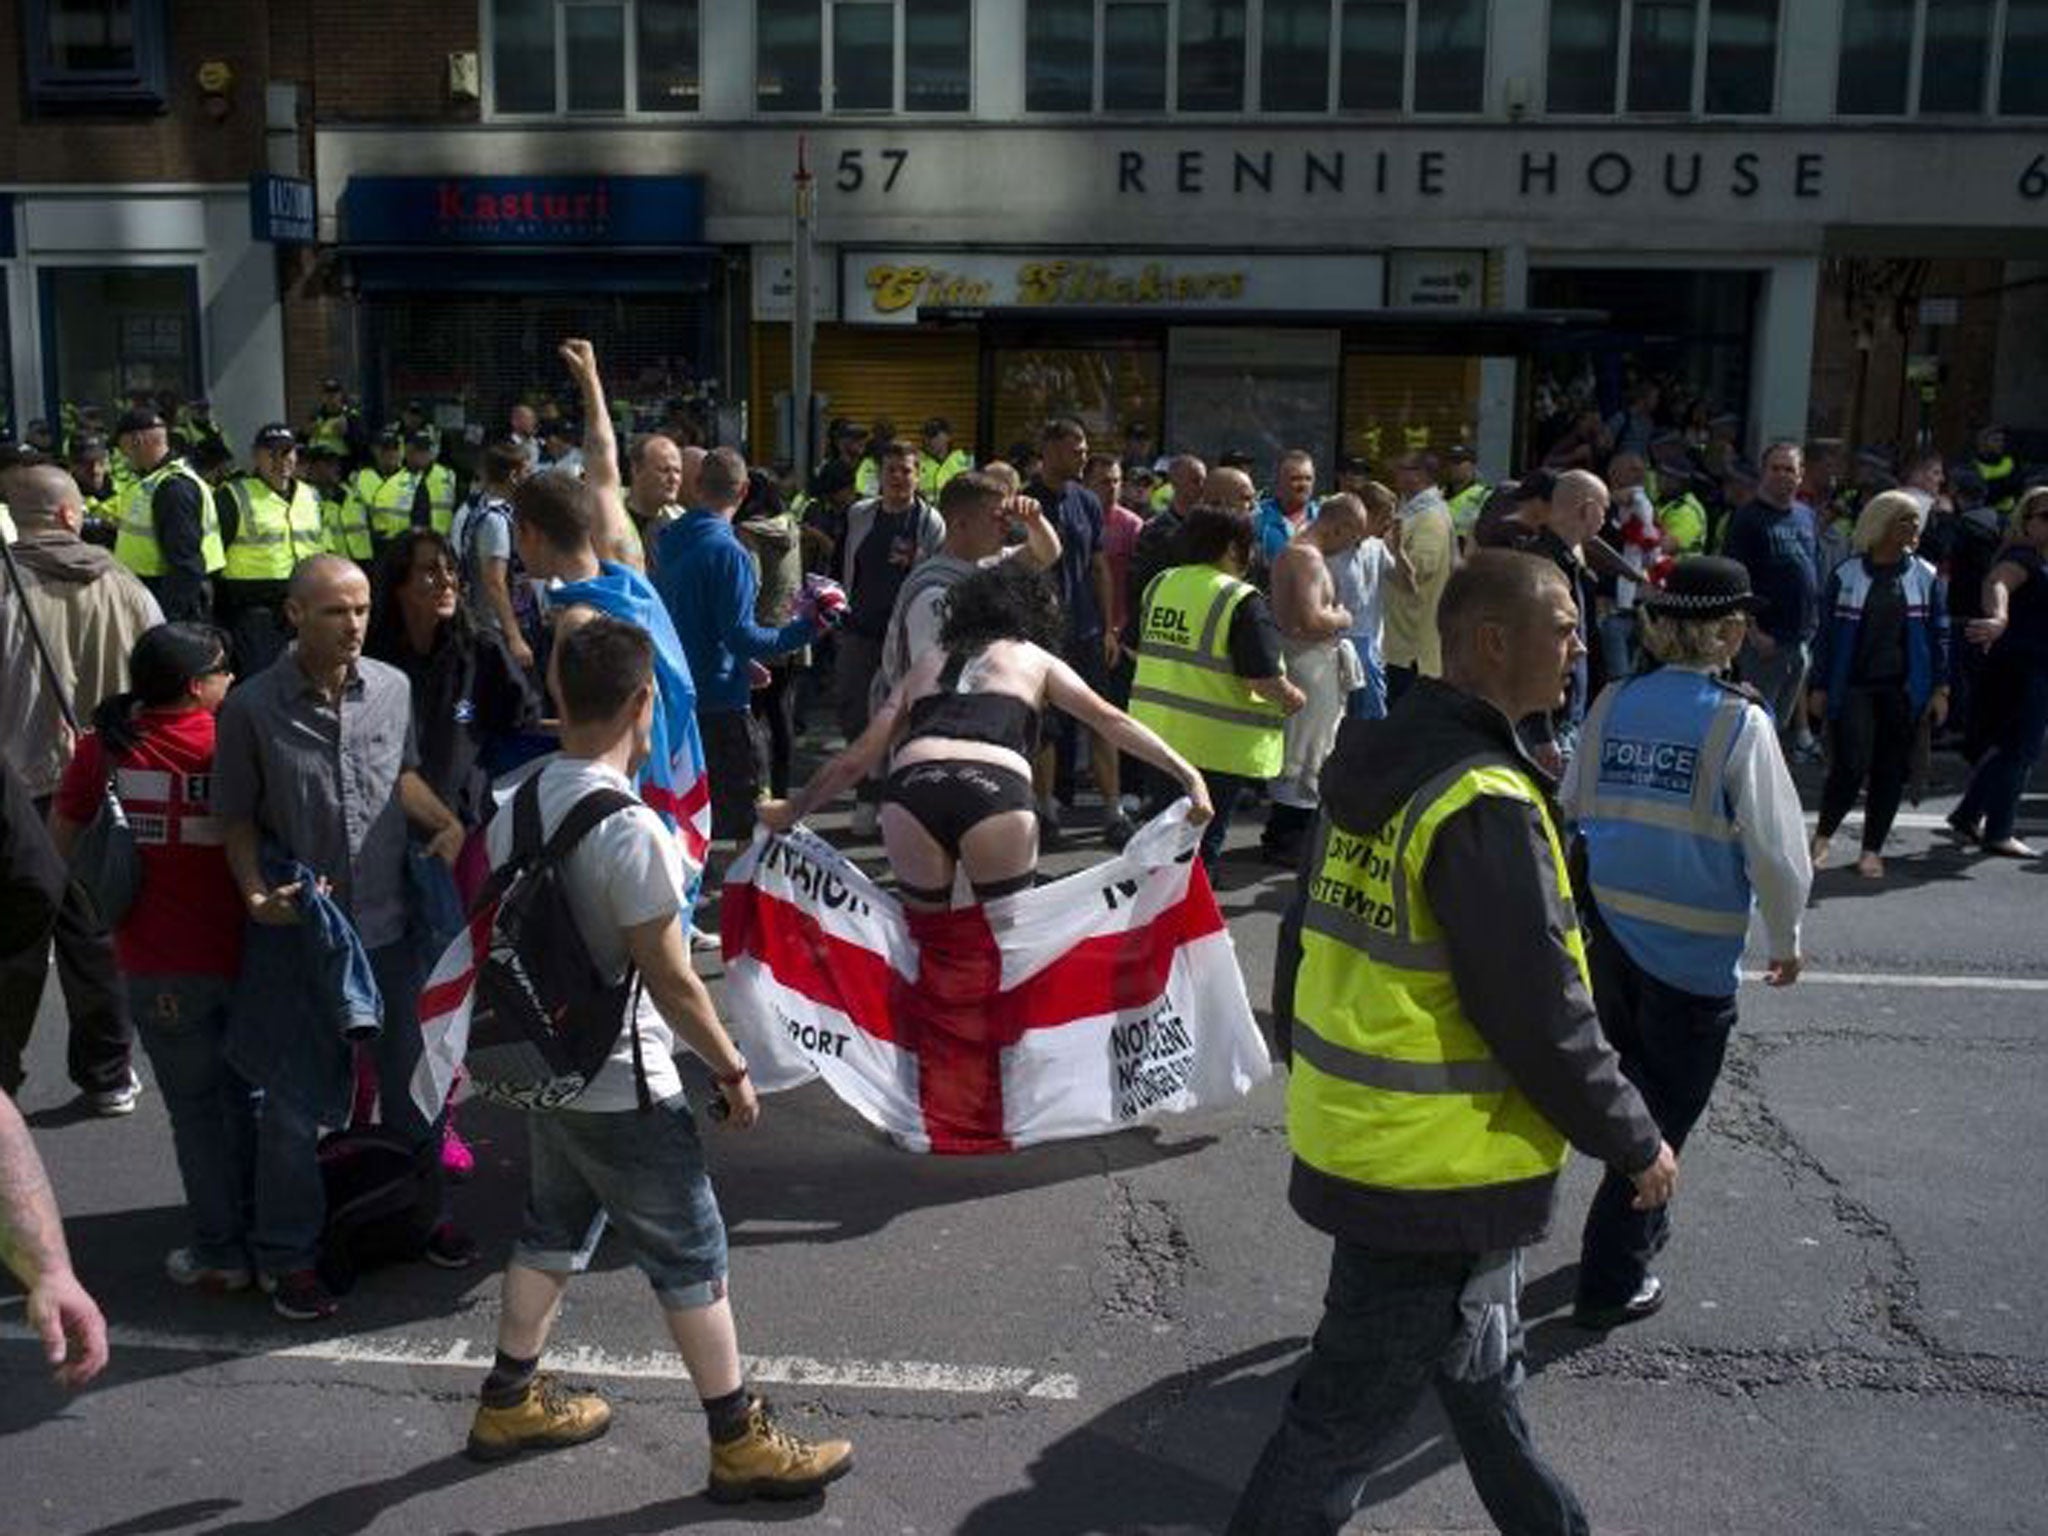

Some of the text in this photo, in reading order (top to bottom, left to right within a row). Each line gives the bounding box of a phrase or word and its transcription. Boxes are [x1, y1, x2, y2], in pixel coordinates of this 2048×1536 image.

[835, 148, 909, 194] 57
[1118, 149, 1826, 198] RENNIE HOUSE
[436, 182, 609, 218] Kasturi
[1151, 606, 1190, 633] EDL
[1602, 742, 1693, 775] POLICE
